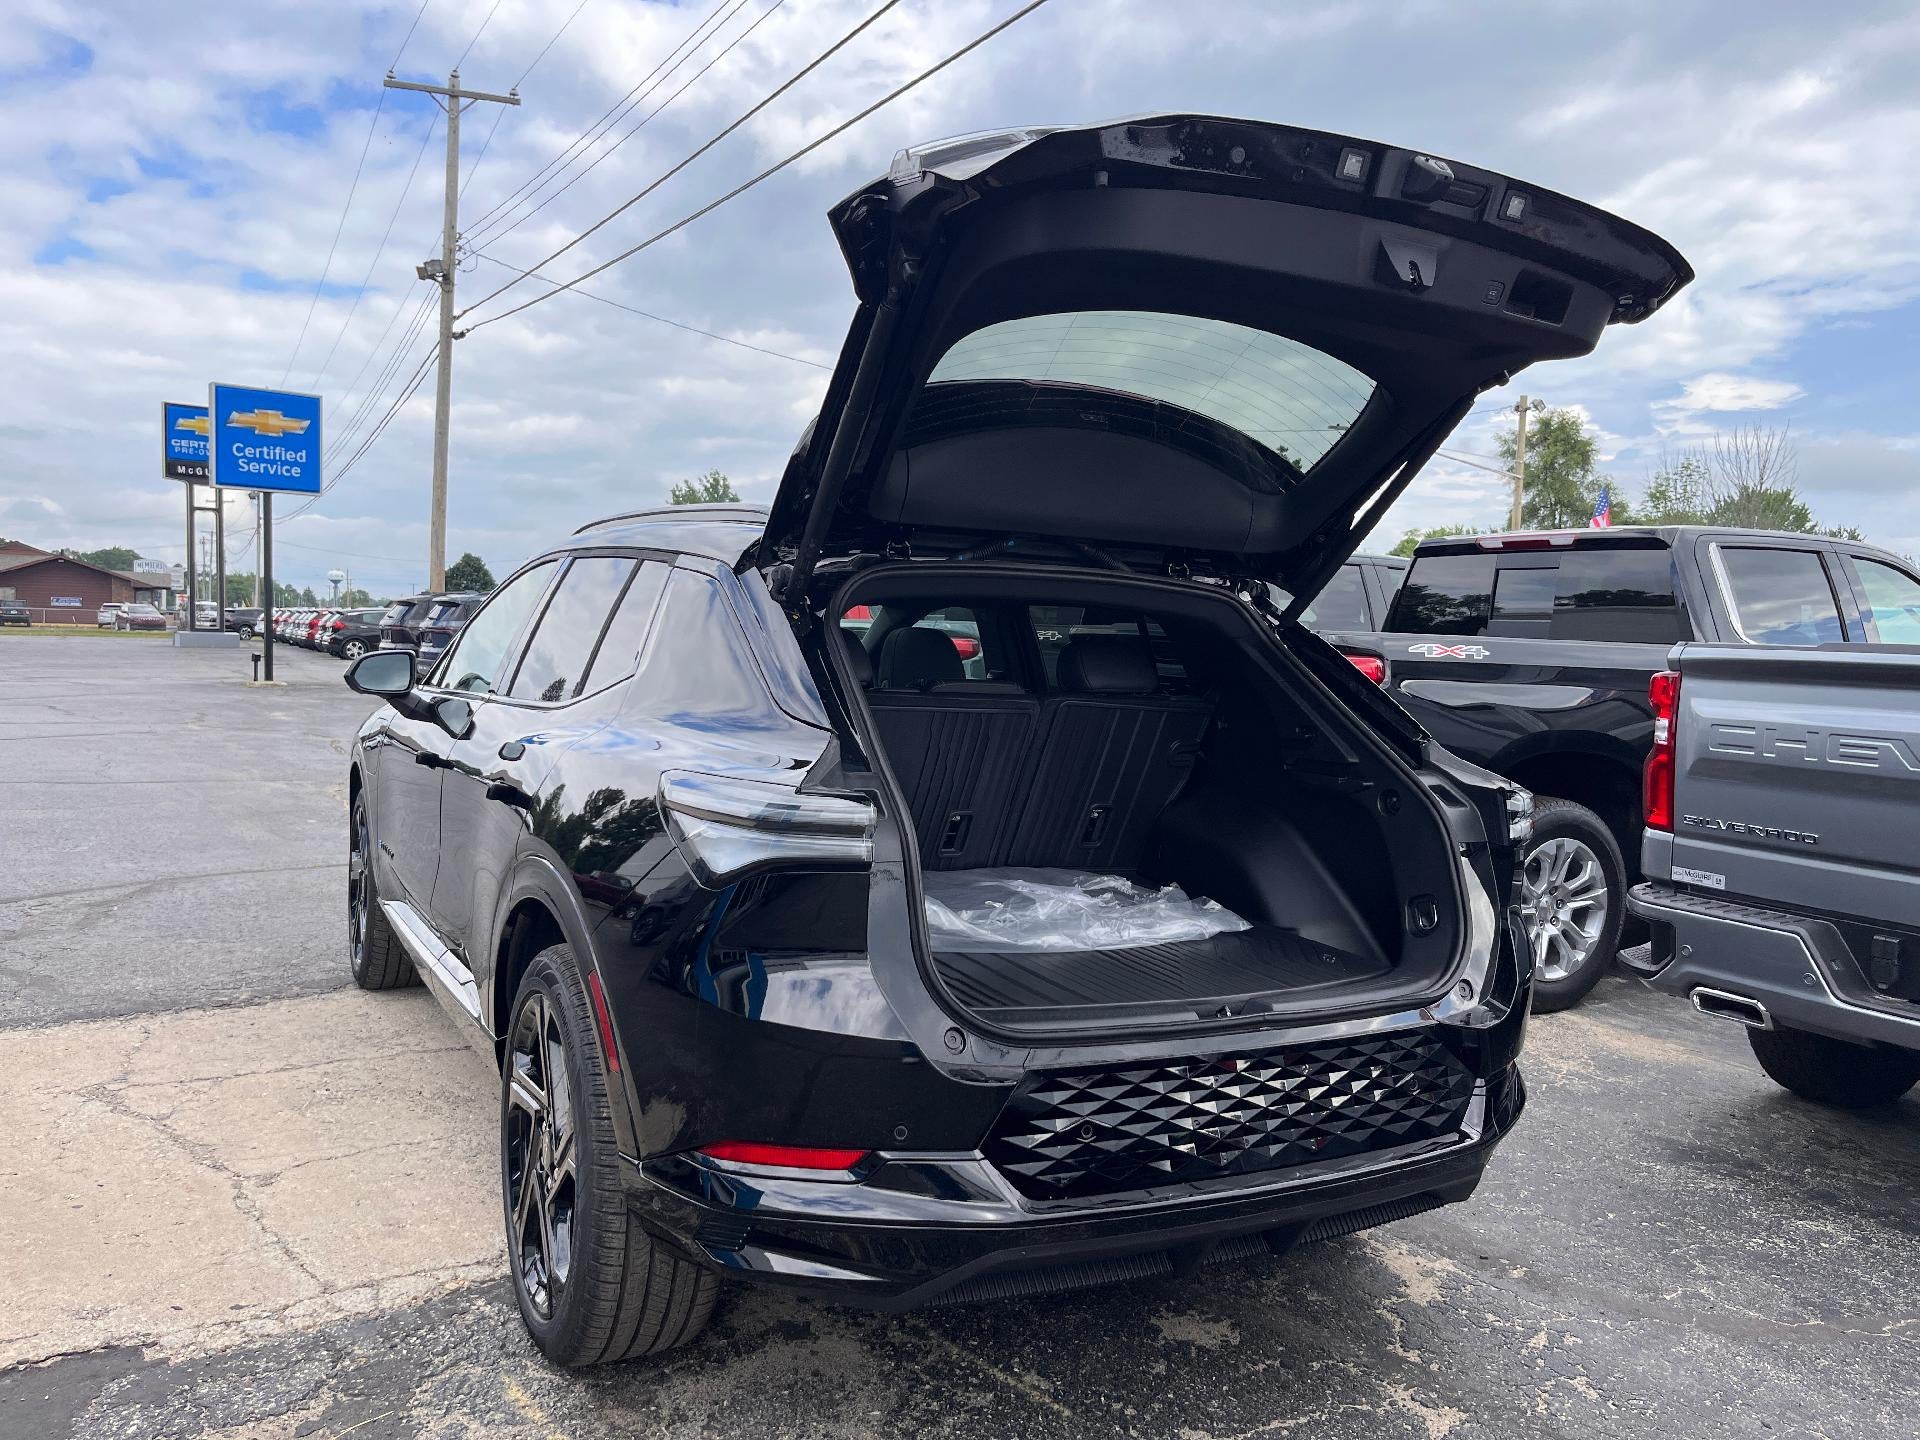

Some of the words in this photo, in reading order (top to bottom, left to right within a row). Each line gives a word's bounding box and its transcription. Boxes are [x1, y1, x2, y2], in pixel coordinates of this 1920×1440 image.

[232, 442, 306, 463] Certified
[238, 458, 301, 477] Service
[1683, 814, 1820, 844] SILVERADO
